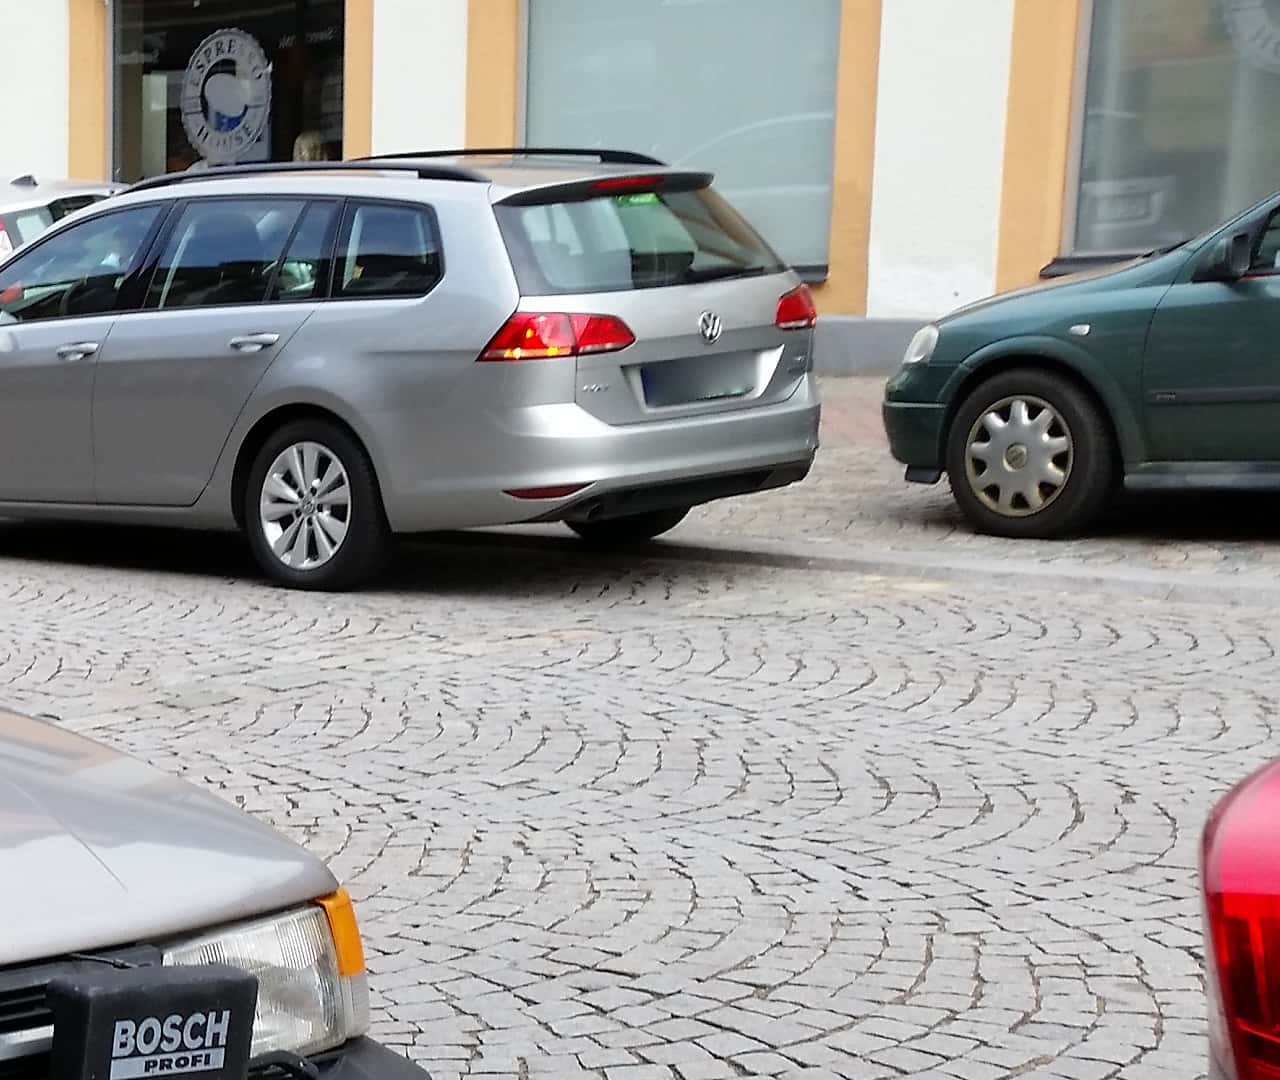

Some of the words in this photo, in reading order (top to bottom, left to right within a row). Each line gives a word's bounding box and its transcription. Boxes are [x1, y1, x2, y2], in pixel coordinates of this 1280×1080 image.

[190, 37, 264, 88] ESPREO
[112, 1009, 231, 1058] BOSCH
[144, 1053, 211, 1073] PROFI
